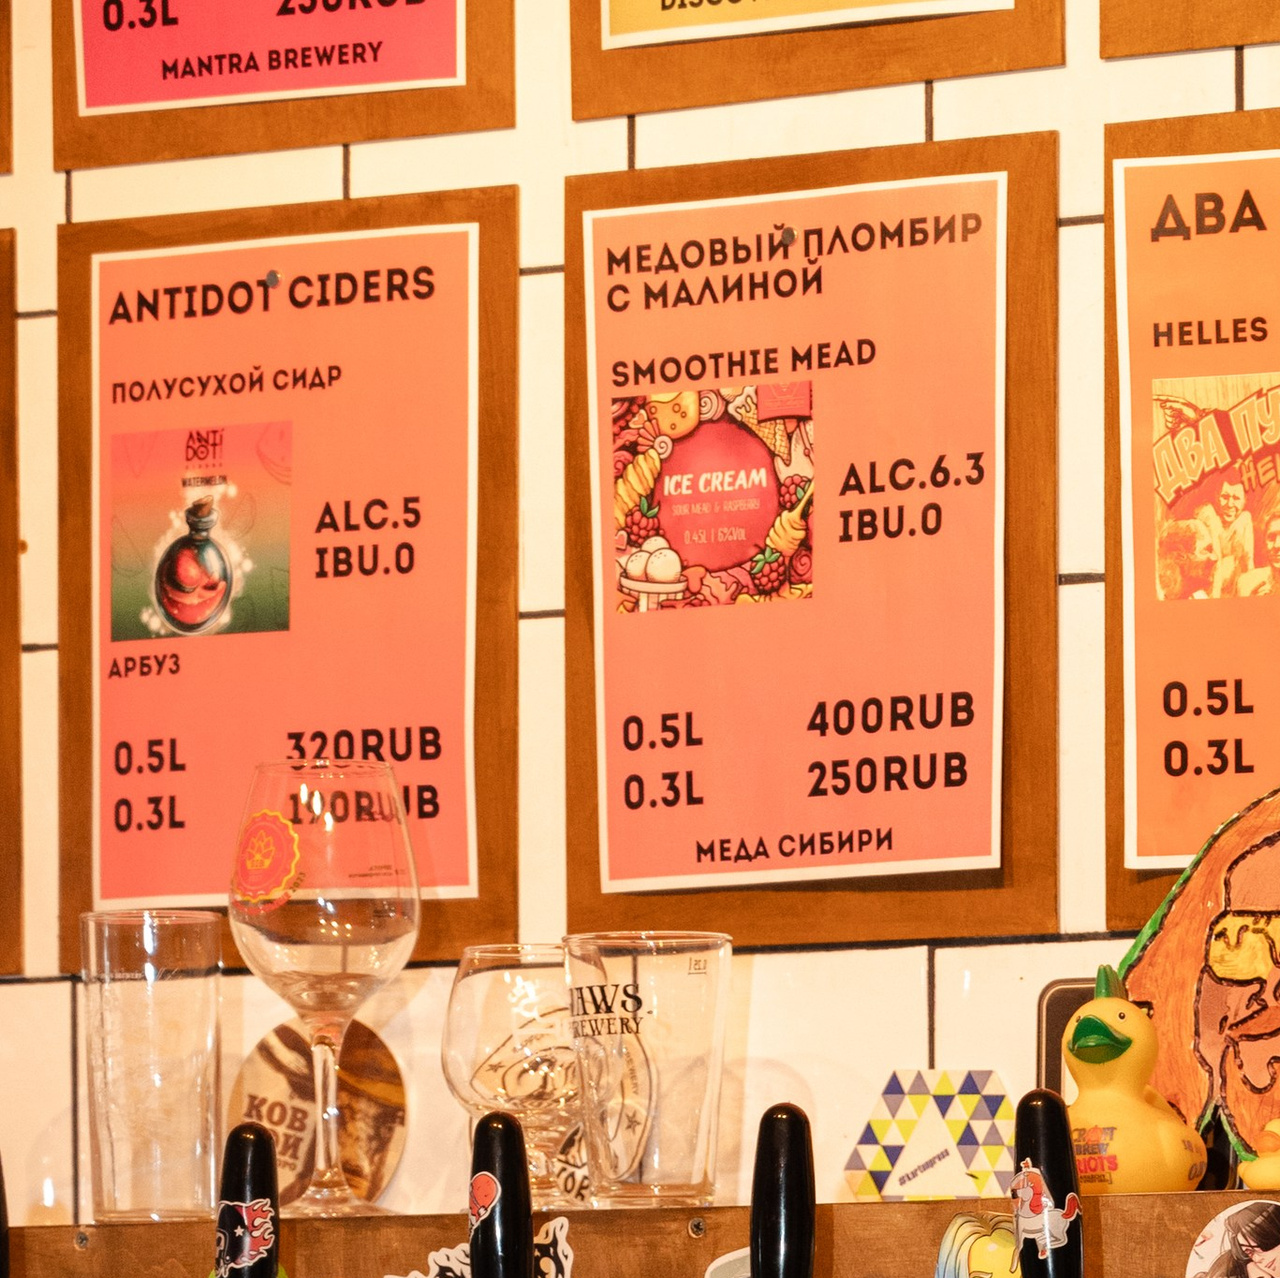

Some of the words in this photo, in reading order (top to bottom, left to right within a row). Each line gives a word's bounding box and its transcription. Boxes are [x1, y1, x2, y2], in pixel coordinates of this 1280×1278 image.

[102, 0, 179, 32] 0.3L
[161, 51, 260, 81] MANTRA
[267, 40, 383, 71] BREWERY
[1150, 189, 1268, 243] ДВА
[606, 223, 796, 276] МЕДОВЫЙ
[803, 213, 982, 258] ПЛОМБИР
[108, 279, 271, 326] ANTIDOT
[288, 265, 435, 309] CIDERS
[606, 284, 630, 313] С
[643, 257, 823, 310] МАЛИНОЙ
[1153, 316, 1268, 348] HELLES
[612, 347, 779, 388] SMOOTHIE
[791, 338, 876, 372] MEAD
[112, 371, 264, 404] ПОЛУСУХОЙ
[272, 365, 342, 391] СИДР
[663, 474, 693, 496] ICE
[698, 467, 767, 493] CREAM
[838, 451, 985, 497] ALC.6.3
[314, 496, 422, 534] ALC.5
[838, 502, 943, 543] IBU.0
[315, 541, 415, 579] IBU.0
[108, 653, 181, 679] АРБУЗ
[1162, 678, 1254, 718] 0.5L
[622, 711, 704, 752] 0.5L
[806, 691, 975, 737] 400RUB
[114, 737, 187, 776] 0.5L
[284, 722, 446, 774] 320RUB
[1163, 738, 1255, 778] 0.3L
[624, 770, 704, 811] 0.3L
[807, 751, 968, 798] 250RUB
[113, 795, 186, 833] 0.3L
[696, 836, 770, 864] МЕДА
[778, 827, 893, 858] СИБИРИ
[571, 1017, 644, 1039] REWERY
